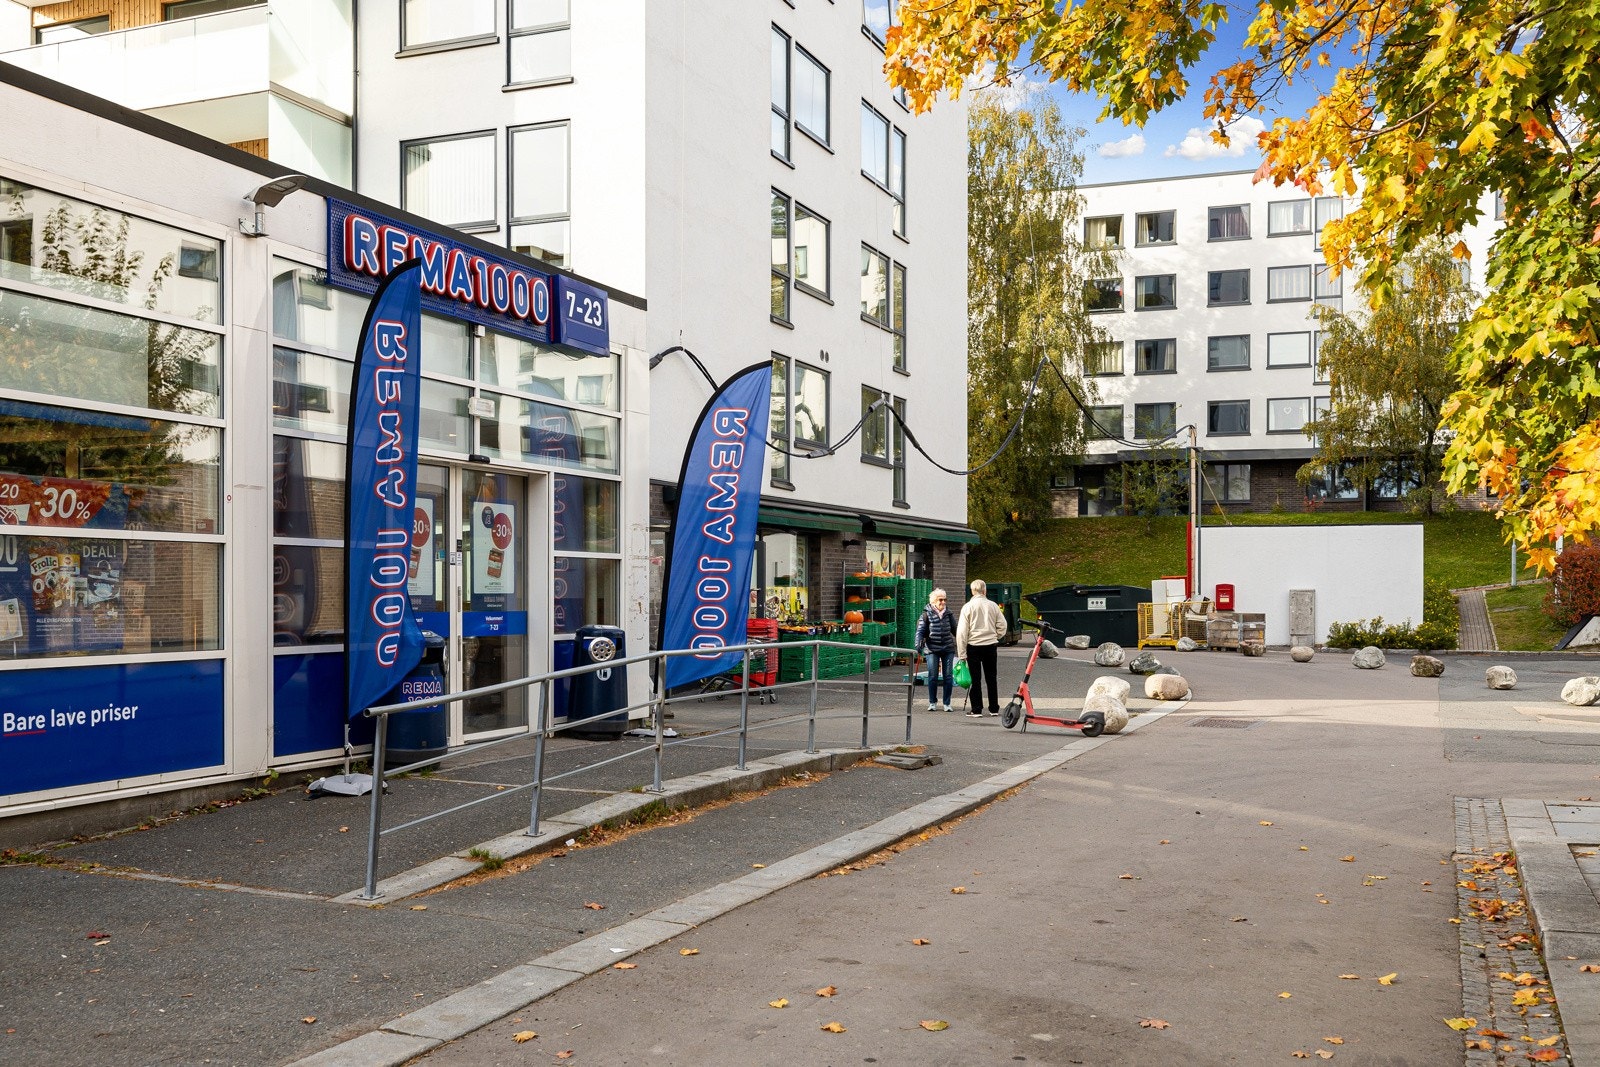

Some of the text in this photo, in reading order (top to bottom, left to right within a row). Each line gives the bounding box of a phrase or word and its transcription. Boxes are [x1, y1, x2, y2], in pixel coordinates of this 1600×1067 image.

[566, 290, 602, 327] 7-23
[34, 487, 91, 520] -30%
[492, 524, 512, 539] -30%
[82, 545, 116, 558] DEAL!
[31, 557, 57, 573] Frolic
[402, 681, 441, 694] REMA
[2, 703, 138, 733] Bare lave priser
